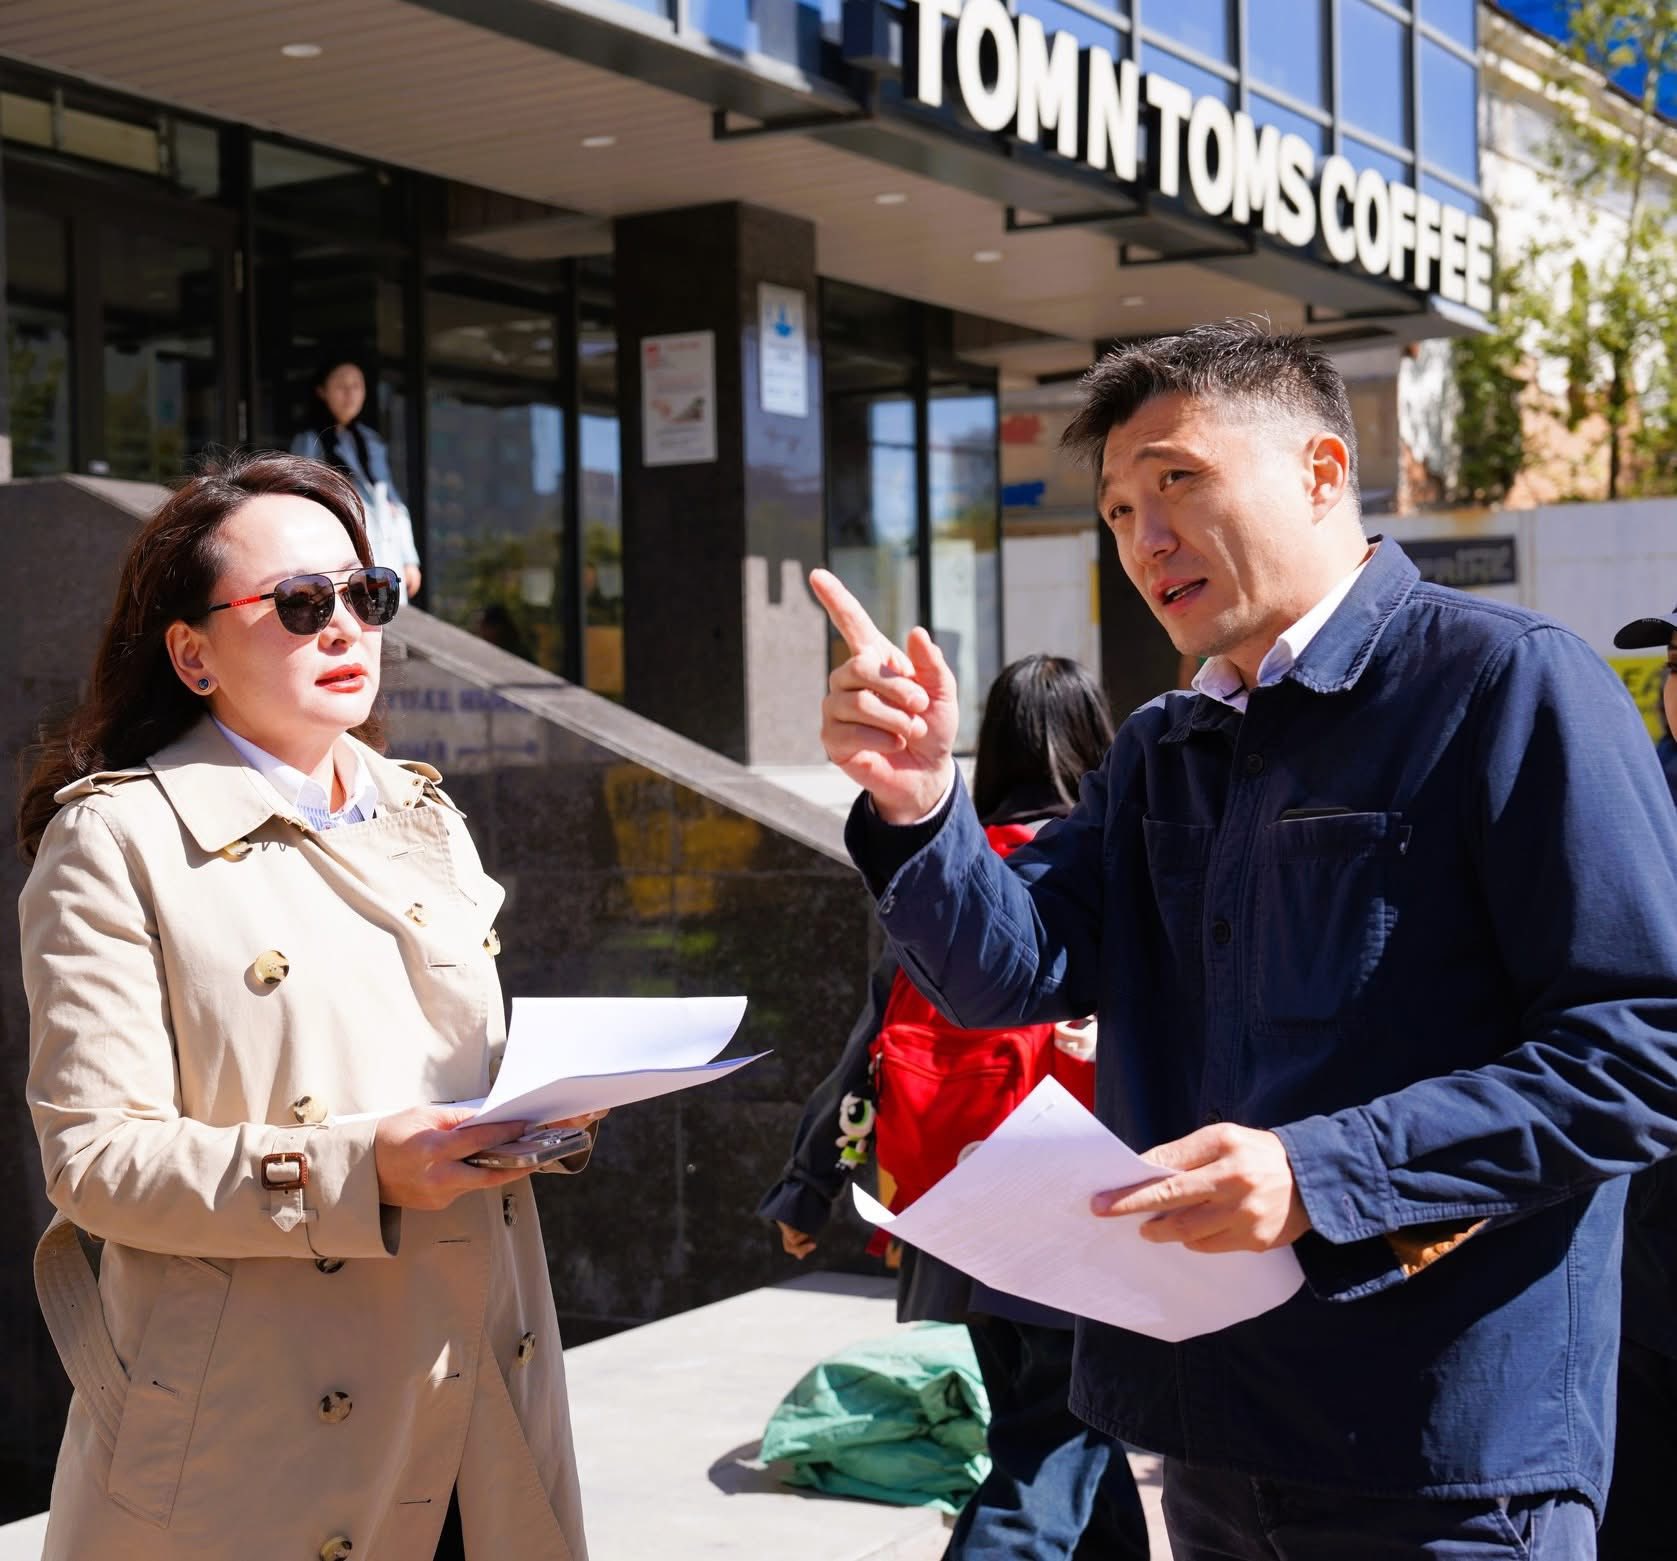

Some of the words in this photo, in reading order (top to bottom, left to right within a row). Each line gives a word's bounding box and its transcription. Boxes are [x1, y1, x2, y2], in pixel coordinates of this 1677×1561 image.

[912, 0, 1079, 160] TOM
[1086, 45, 1140, 182] N
[1146, 73, 1317, 247] TOMS
[1320, 154, 1493, 312] COFFEE
